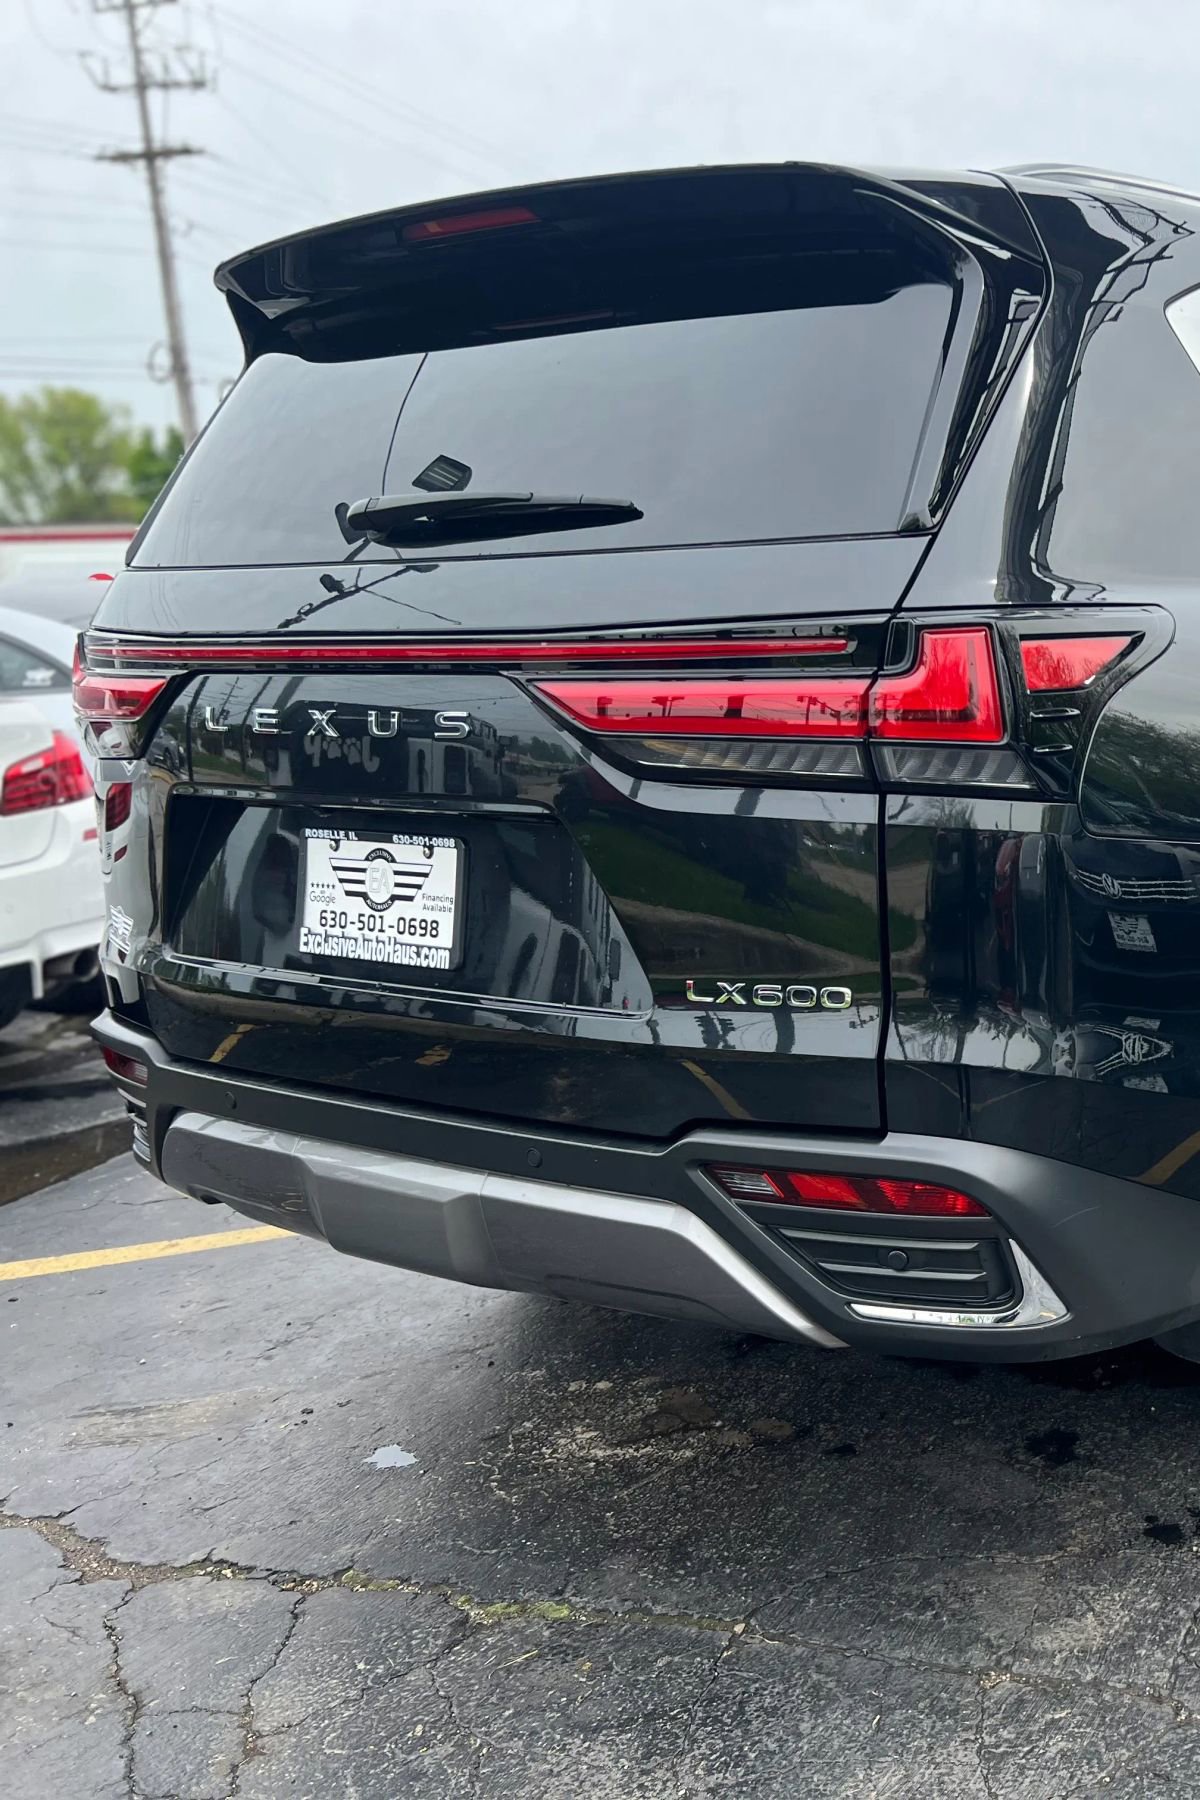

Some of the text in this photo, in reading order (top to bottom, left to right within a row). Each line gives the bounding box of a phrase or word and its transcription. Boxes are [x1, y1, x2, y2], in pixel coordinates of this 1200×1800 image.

[205, 706, 472, 739] LEXUS
[349, 832, 359, 841] IL
[392, 835, 456, 848] 630-501-0698
[310, 890, 337, 906] Google
[422, 893, 454, 905] Financing
[422, 903, 453, 913] Available
[319, 909, 440, 938] 630-501-0698
[300, 926, 450, 970] ExclusiveAutoHaus.com
